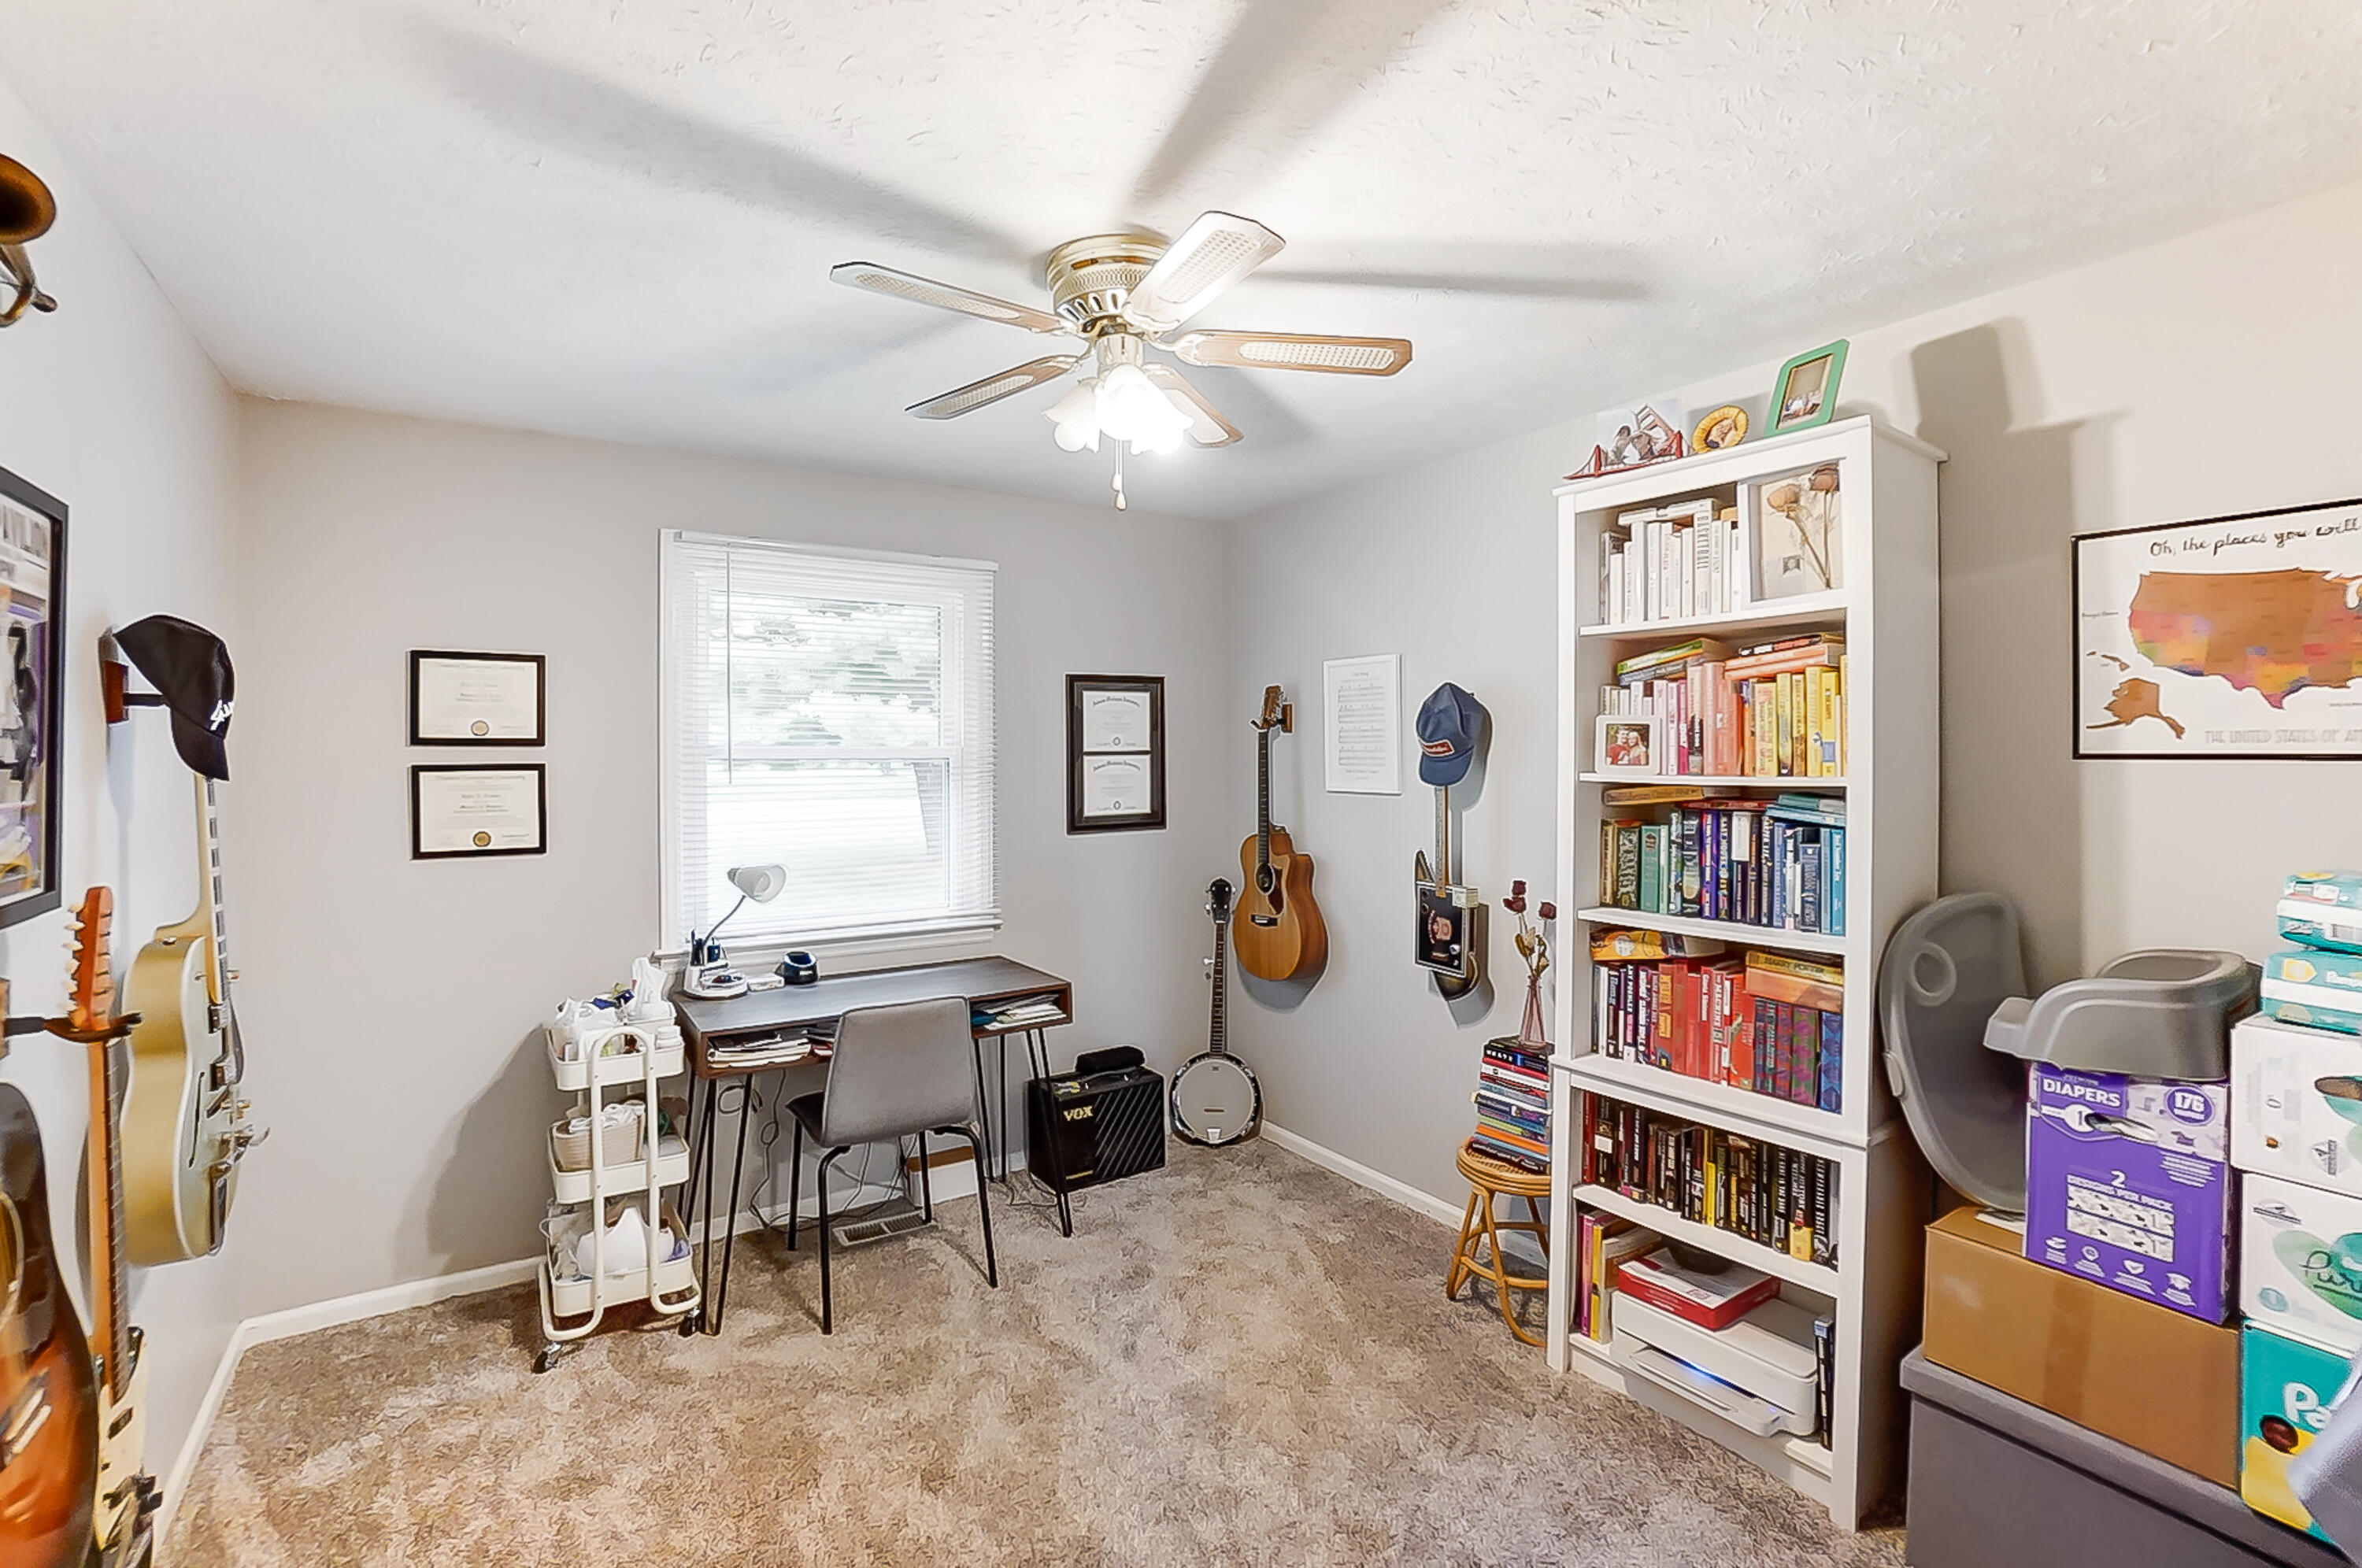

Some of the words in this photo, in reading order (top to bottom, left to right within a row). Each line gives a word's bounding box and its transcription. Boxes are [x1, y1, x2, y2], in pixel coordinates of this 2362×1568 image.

[1697, 516, 1710, 570] BASKETBALL
[2150, 541, 2177, 557] Oh,
[2182, 537, 2208, 551] the
[2213, 533, 2267, 557] places
[2274, 530, 2307, 548] you
[2205, 730, 2226, 744] THE
[2230, 730, 2271, 744] UNITED
[2275, 730, 2318, 744] STATES
[2043, 1078, 2121, 1107] DIAPERS
[2175, 1092, 2205, 1112] 176
[1064, 1106, 1094, 1122] VOX
[2110, 1170, 2126, 1188] 2
